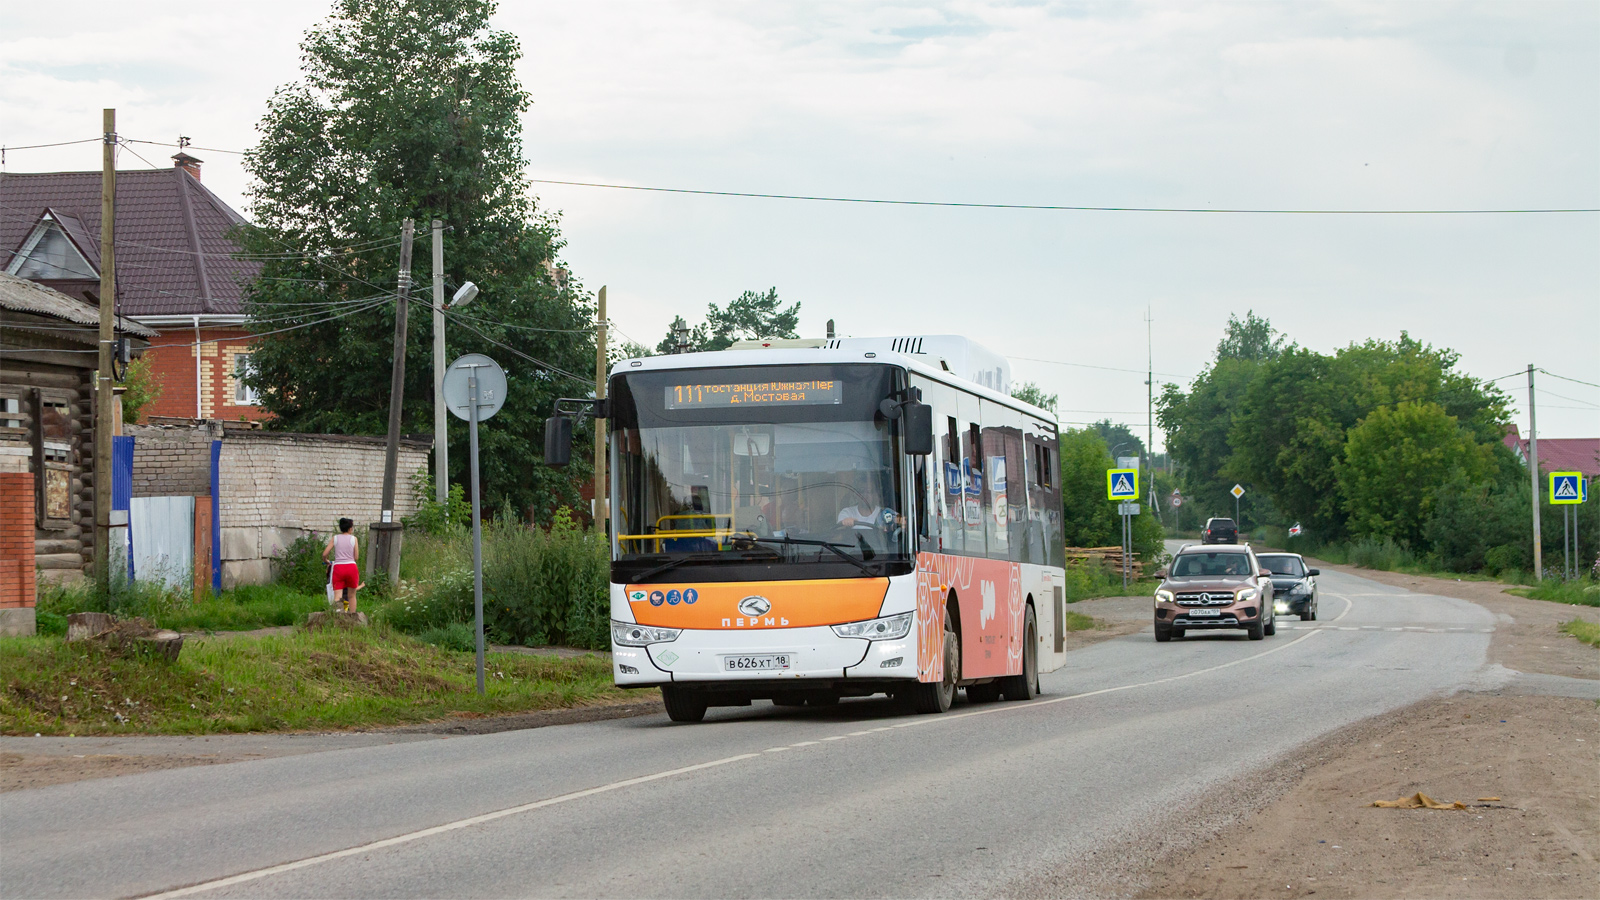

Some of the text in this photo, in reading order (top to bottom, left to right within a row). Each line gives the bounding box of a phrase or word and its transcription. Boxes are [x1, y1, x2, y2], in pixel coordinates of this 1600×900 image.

[674, 384, 702, 403] 111
[704, 382, 769, 394] тостанция
[770, 381, 810, 392] Южная
[730, 392, 805, 404] д. Мостовая
[721, 617, 790, 627] ПЕРМЬ
[775, 656, 786, 665] 18
